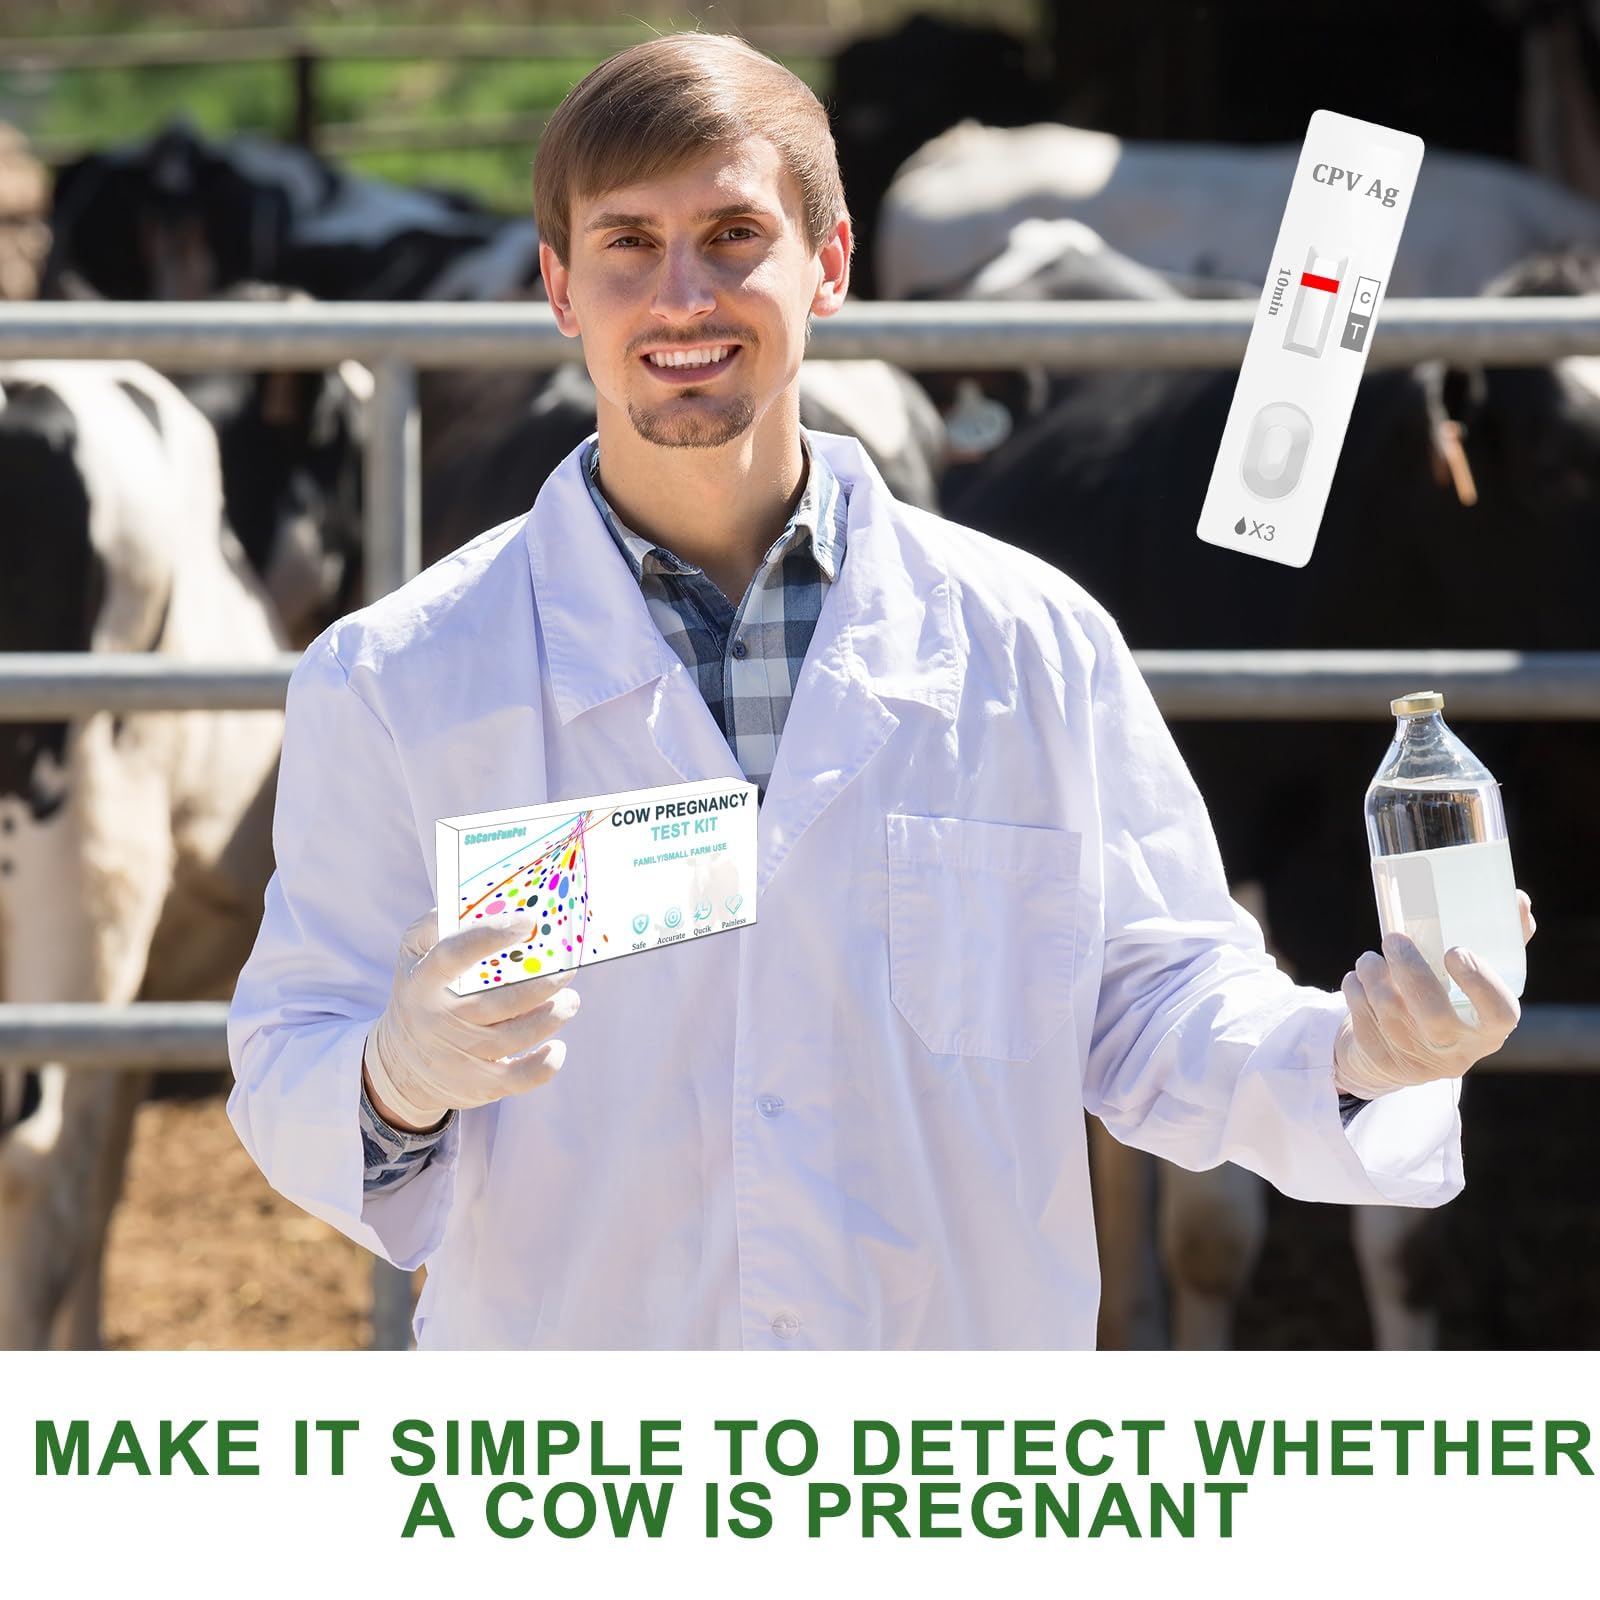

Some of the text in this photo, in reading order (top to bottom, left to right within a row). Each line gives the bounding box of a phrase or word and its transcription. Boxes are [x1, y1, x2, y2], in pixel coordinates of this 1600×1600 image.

[1312, 163, 1400, 208] CPV Ag
[1268, 267, 1292, 316] 10min
[1360, 291, 1372, 304] C
[1350, 322, 1364, 340] T
[1248, 520, 1276, 542] X3
[611, 792, 749, 827] COW PREGNANCY
[651, 816, 718, 841] TEST KIT
[633, 842, 728, 867] FAMILY/SMALL FARM USE
[721, 917, 747, 929] Painless
[631, 940, 647, 951] Safe
[656, 931, 686, 945] Accurate
